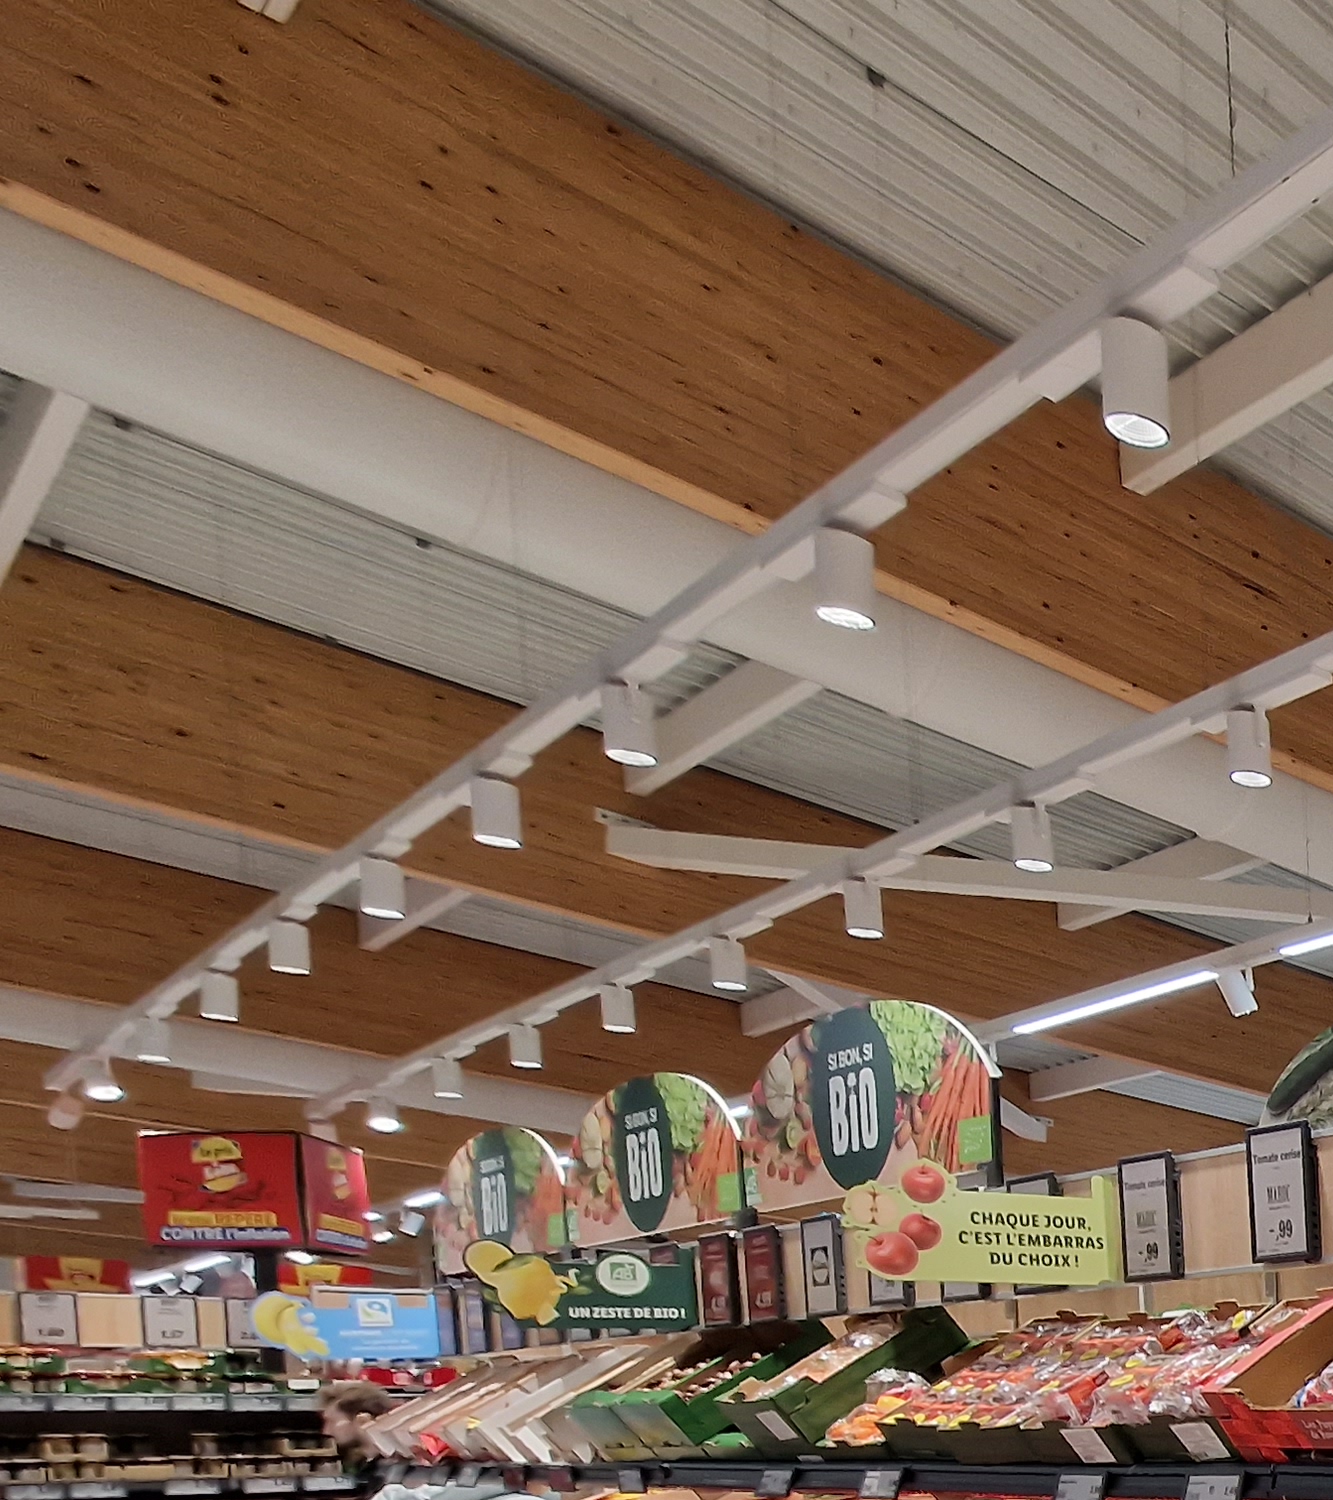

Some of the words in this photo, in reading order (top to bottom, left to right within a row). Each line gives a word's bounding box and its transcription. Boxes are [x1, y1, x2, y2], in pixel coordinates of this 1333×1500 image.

[1253, 1153, 1278, 1165] Tomate
[970, 1211, 1039, 1229] CHAQUE
[1044, 1213, 1092, 1232] JOUR,
[958, 1230, 1001, 1246] C'EST
[1007, 1233, 1104, 1250] L'EMBARRAS
[990, 1252, 1013, 1266] DU
[1019, 1254, 1071, 1268] CHOIX
[568, 1306, 589, 1319] UN
[591, 1306, 632, 1319] ZESTE
[634, 1306, 651, 1319] DE
[653, 1306, 679, 1319] BIO
